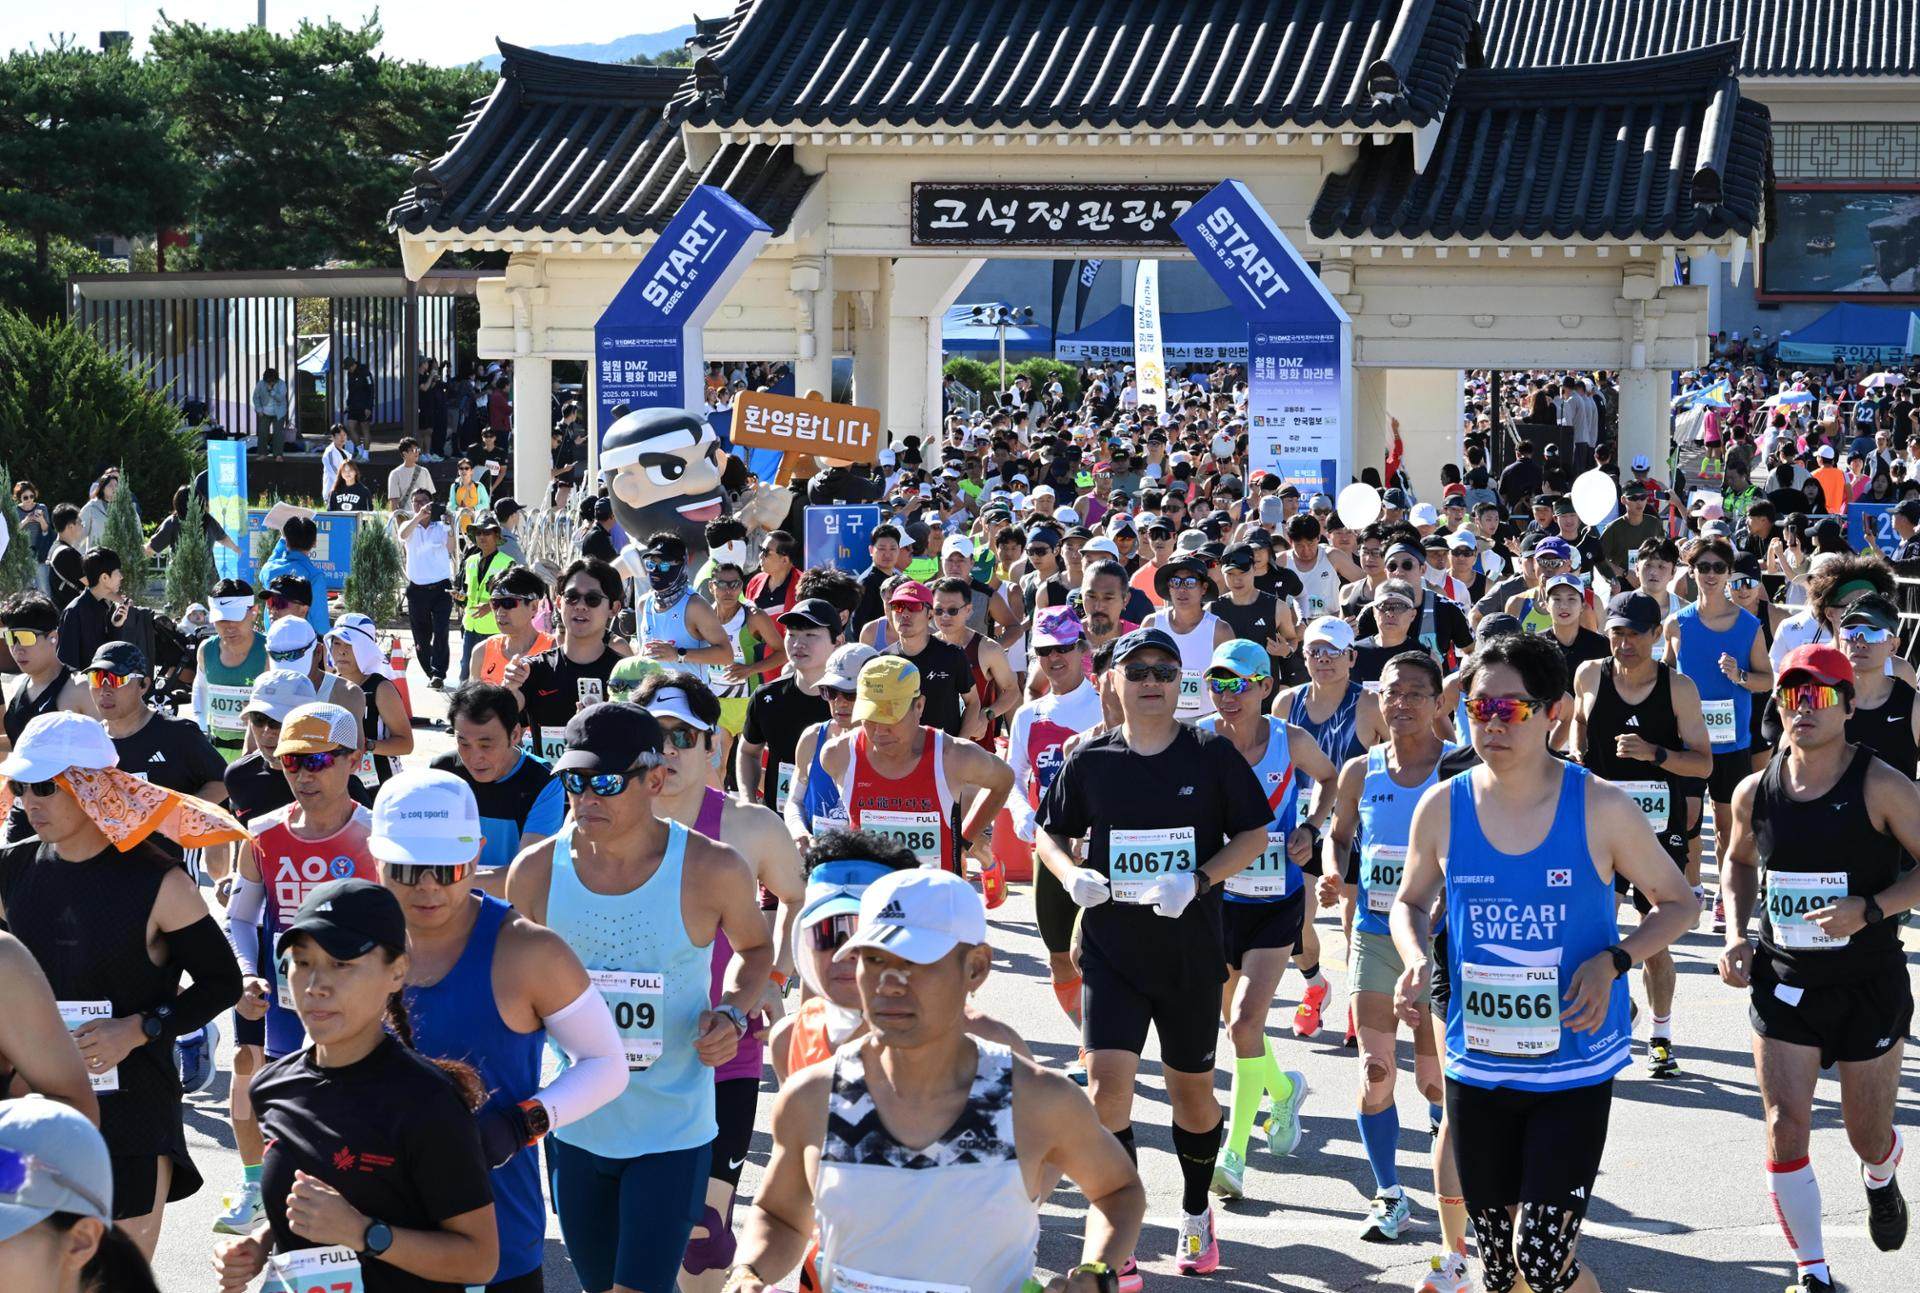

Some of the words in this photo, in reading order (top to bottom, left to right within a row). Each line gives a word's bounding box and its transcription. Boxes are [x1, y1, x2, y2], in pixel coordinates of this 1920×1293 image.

[1206, 206, 1290, 298] START
[642, 210, 716, 308] START
[1081, 345, 1135, 357] 근육경련에
[1194, 346, 1213, 358] 현장
[624, 361, 648, 371] DMZ
[1255, 357, 1275, 369] 철원
[1278, 358, 1303, 367] DMZ
[602, 371, 621, 383] 국제
[625, 371, 645, 382] 평화
[647, 371, 677, 382] 마라톤
[1255, 368, 1275, 380] 국제
[1280, 368, 1300, 380] 평화
[1303, 368, 1334, 380] 마라톤
[1857, 407, 1873, 422] 22
[744, 405, 872, 447] 환영합니다
[824, 514, 863, 534] 입구
[838, 545, 850, 558] In
[211, 698, 250, 712] 4073
[409, 811, 423, 820] coq
[1170, 832, 1192, 840] FULL
[1114, 849, 1191, 874] 40673
[1820, 877, 1845, 885] FULL
[1469, 904, 1566, 922] POCARI
[1472, 922, 1557, 940] SWEAT
[1526, 971, 1555, 981] FULL
[630, 978, 660, 988] FULL
[81, 1006, 110, 1015] FULL
[1466, 991, 1552, 1019] 40566
[320, 1250, 356, 1265] FULL
